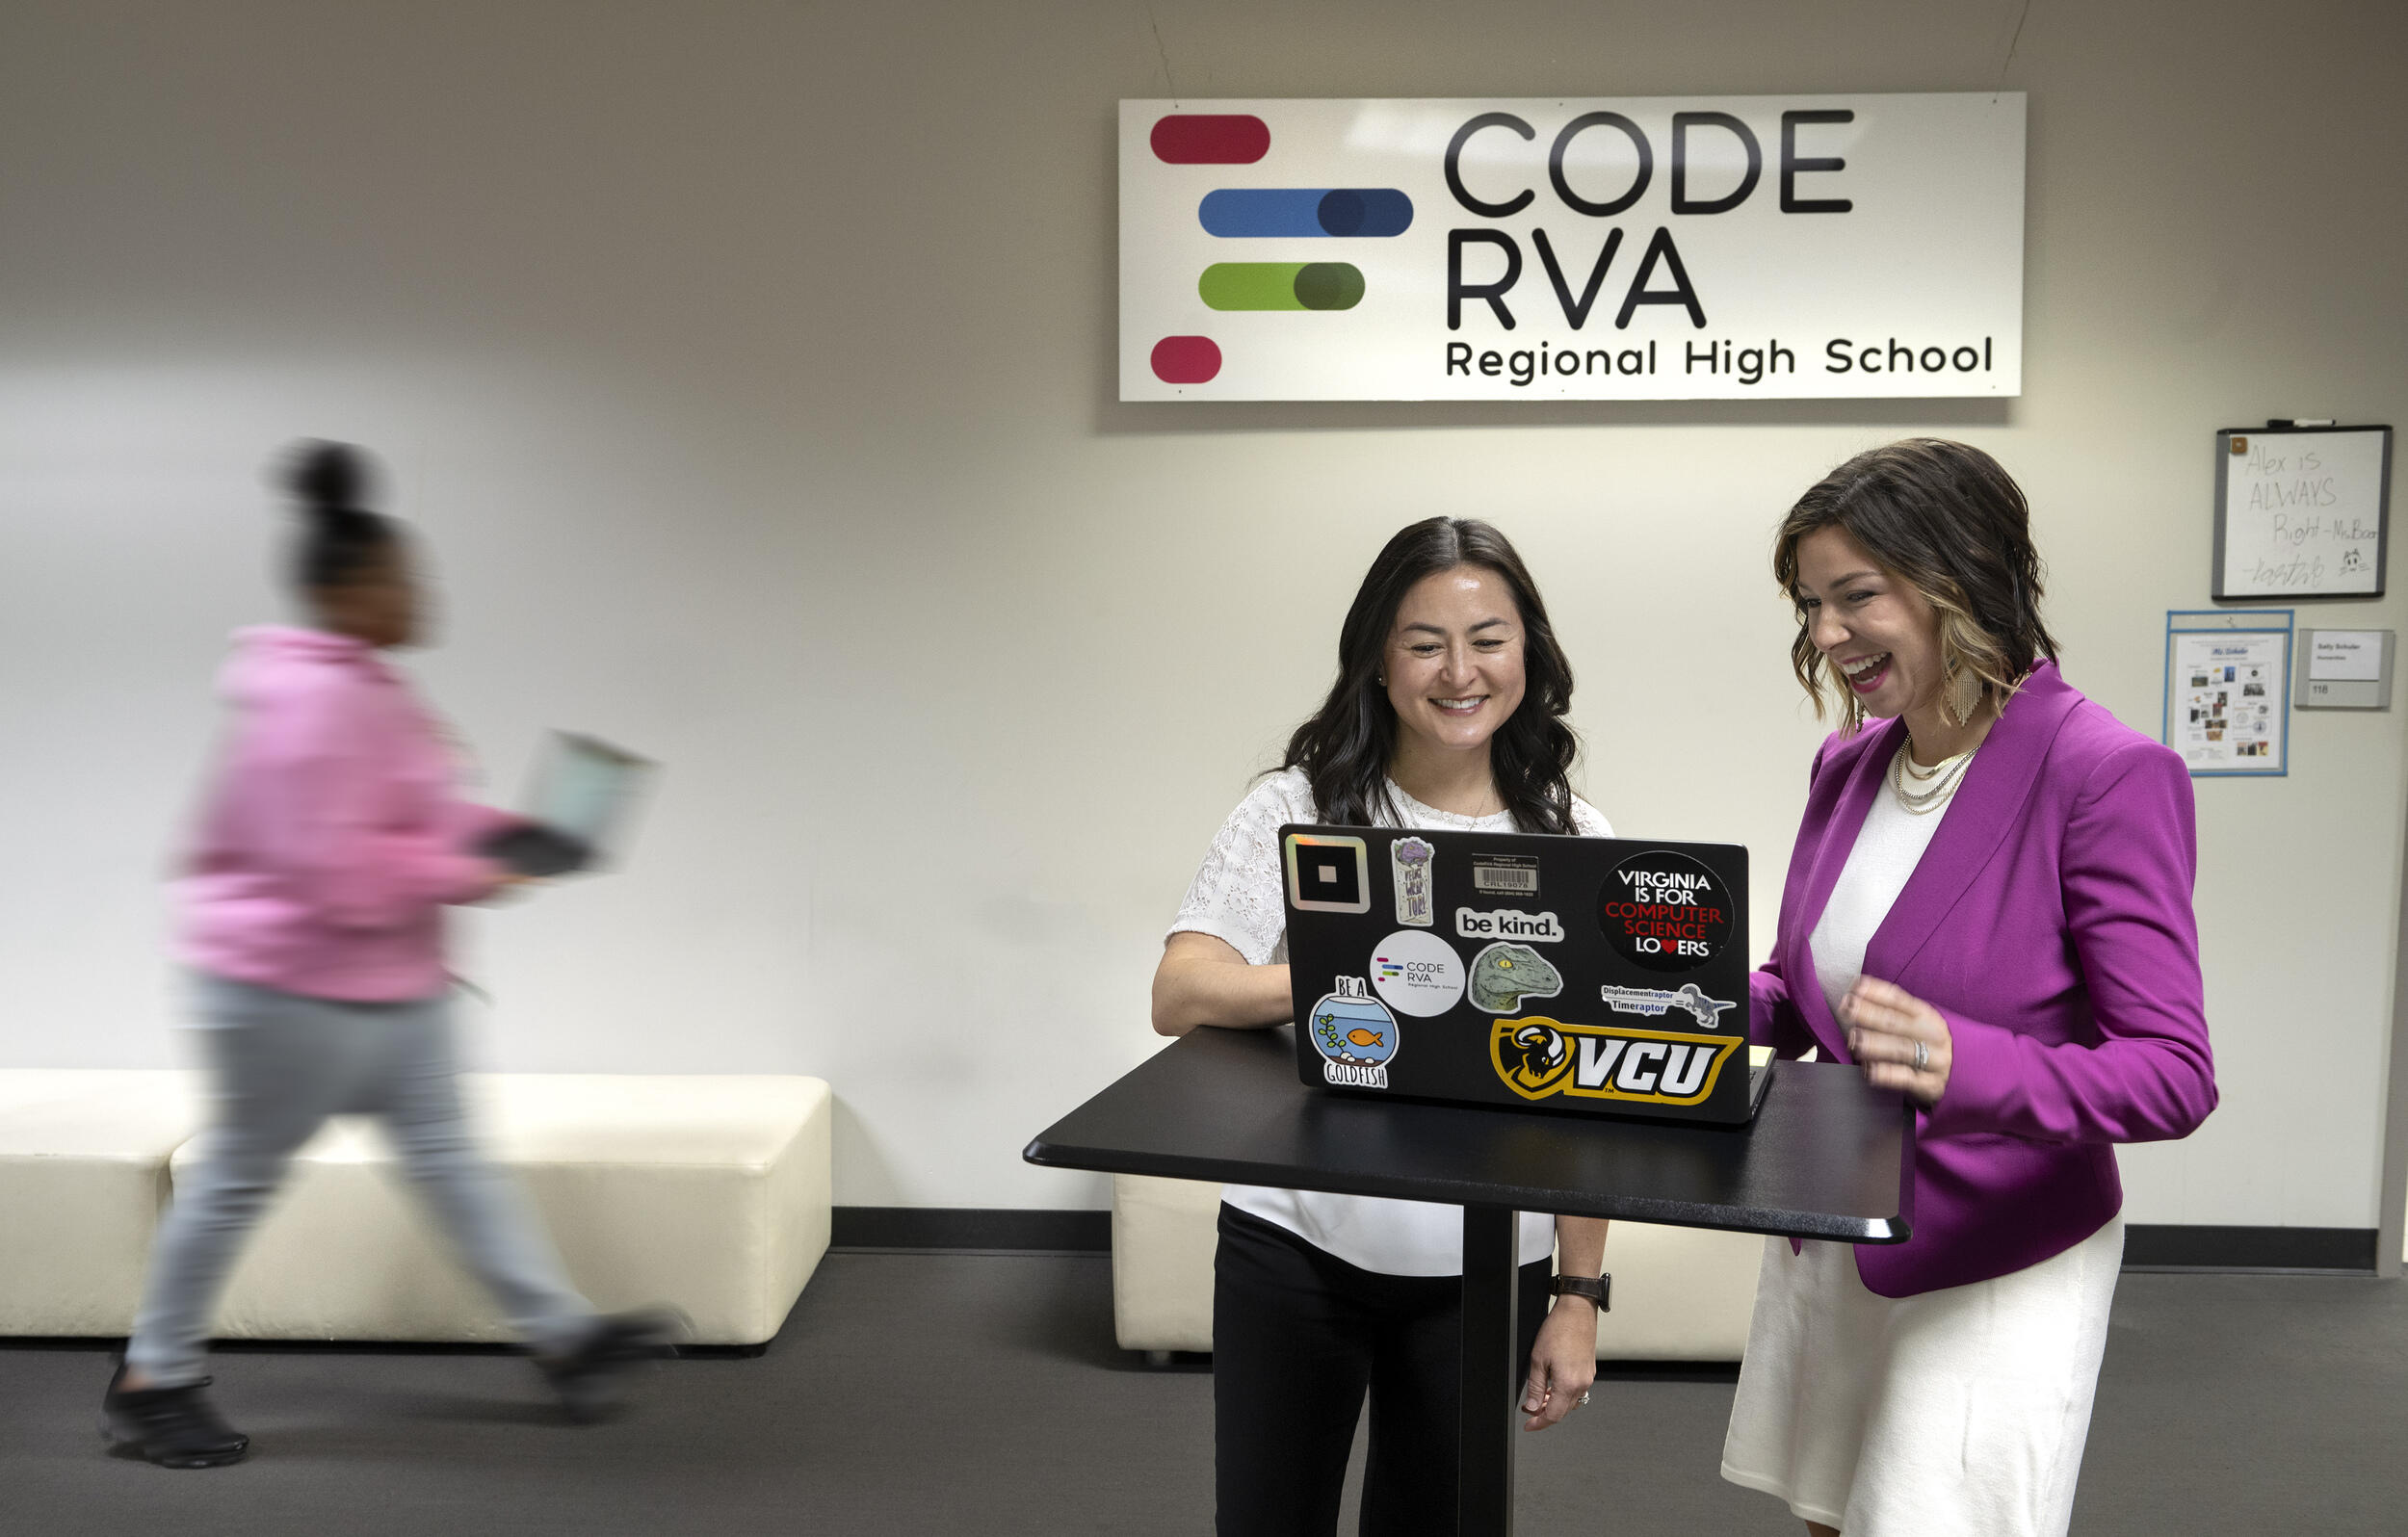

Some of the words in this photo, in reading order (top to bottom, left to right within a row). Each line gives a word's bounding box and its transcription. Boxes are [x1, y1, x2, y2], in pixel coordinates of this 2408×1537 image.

[1444, 110, 1855, 218] CODE
[1448, 226, 1707, 330] RVA
[1446, 340, 1656, 387] Regional
[1685, 338, 1795, 385] High
[1825, 337, 1993, 374] School
[2246, 445, 2286, 476] Alex
[2299, 453, 2321, 470] is
[2249, 478, 2337, 510] ALWAYS
[2273, 513, 2320, 546] Right
[1617, 870, 1712, 891] VIRGINIA
[1635, 887, 1650, 902] IS
[1656, 888, 1698, 905] FOR
[1605, 901, 1724, 924] COMPUTER
[1463, 914, 1492, 932] be
[1499, 916, 1557, 936] kind.
[1624, 920, 1707, 939] SCIENCE
[1406, 962, 1445, 974] CODE
[1407, 972, 1432, 982] RVA
[1338, 978, 1352, 997] BE
[1357, 979, 1365, 997] A
[1603, 986, 1673, 1000] Displacementraptor
[1612, 1000, 1665, 1013] Timeraptor
[1326, 1064, 1386, 1086] GOLDFISH
[1578, 1036, 1717, 1095] VCU
